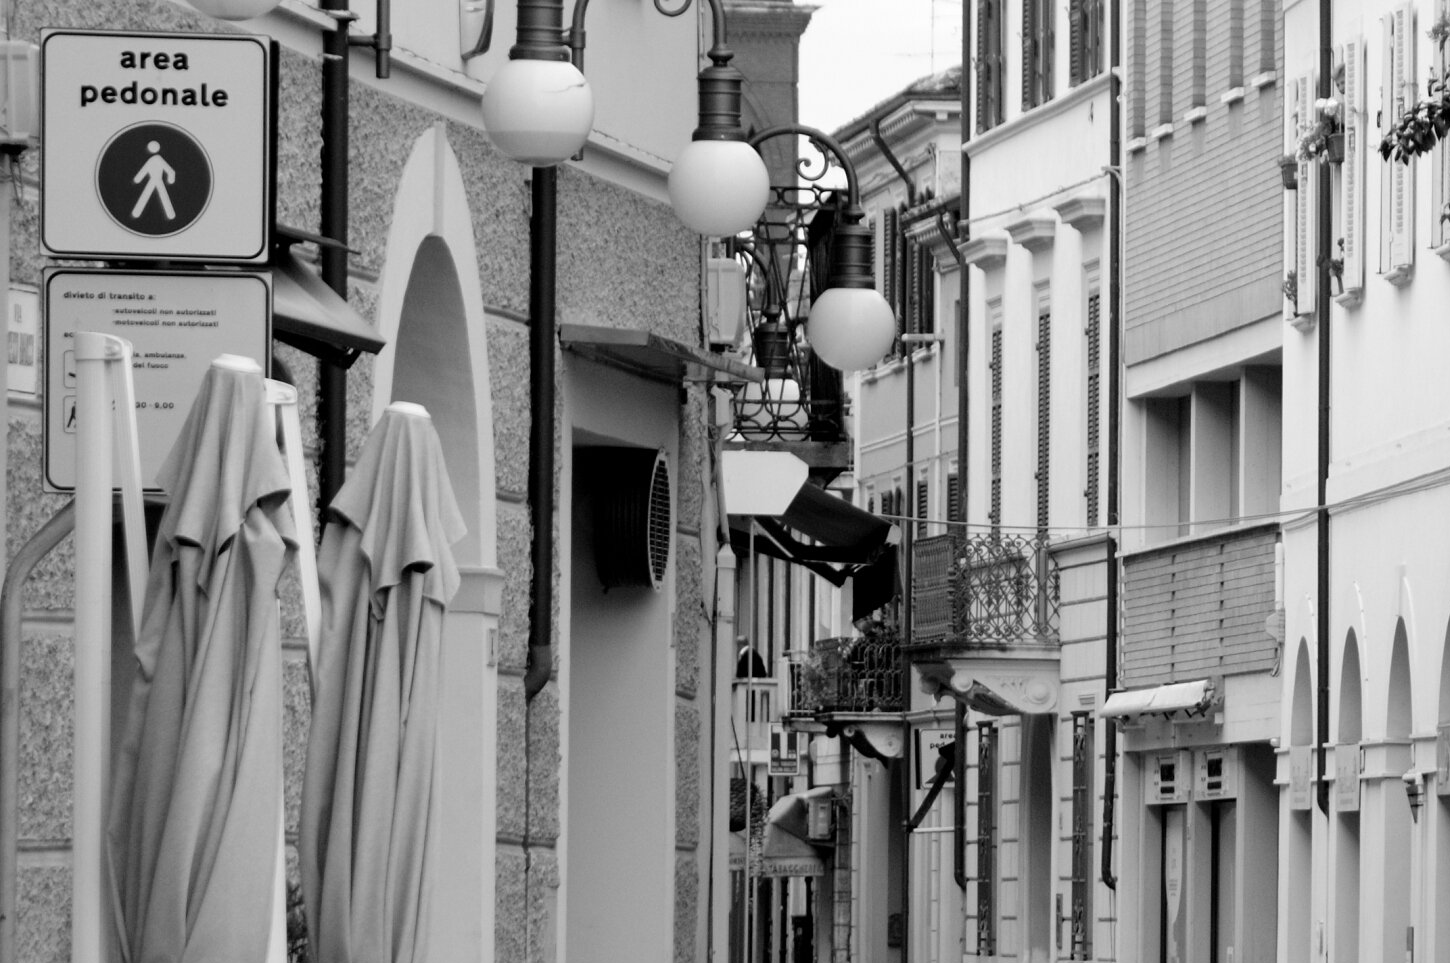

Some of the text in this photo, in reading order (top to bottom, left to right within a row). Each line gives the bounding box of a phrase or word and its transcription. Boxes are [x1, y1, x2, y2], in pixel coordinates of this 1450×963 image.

[120, 51, 189, 70] area
[80, 80, 229, 107] pedonale
[64, 291, 95, 299] divieto
[98, 291, 106, 299] di
[109, 292, 145, 300] transito
